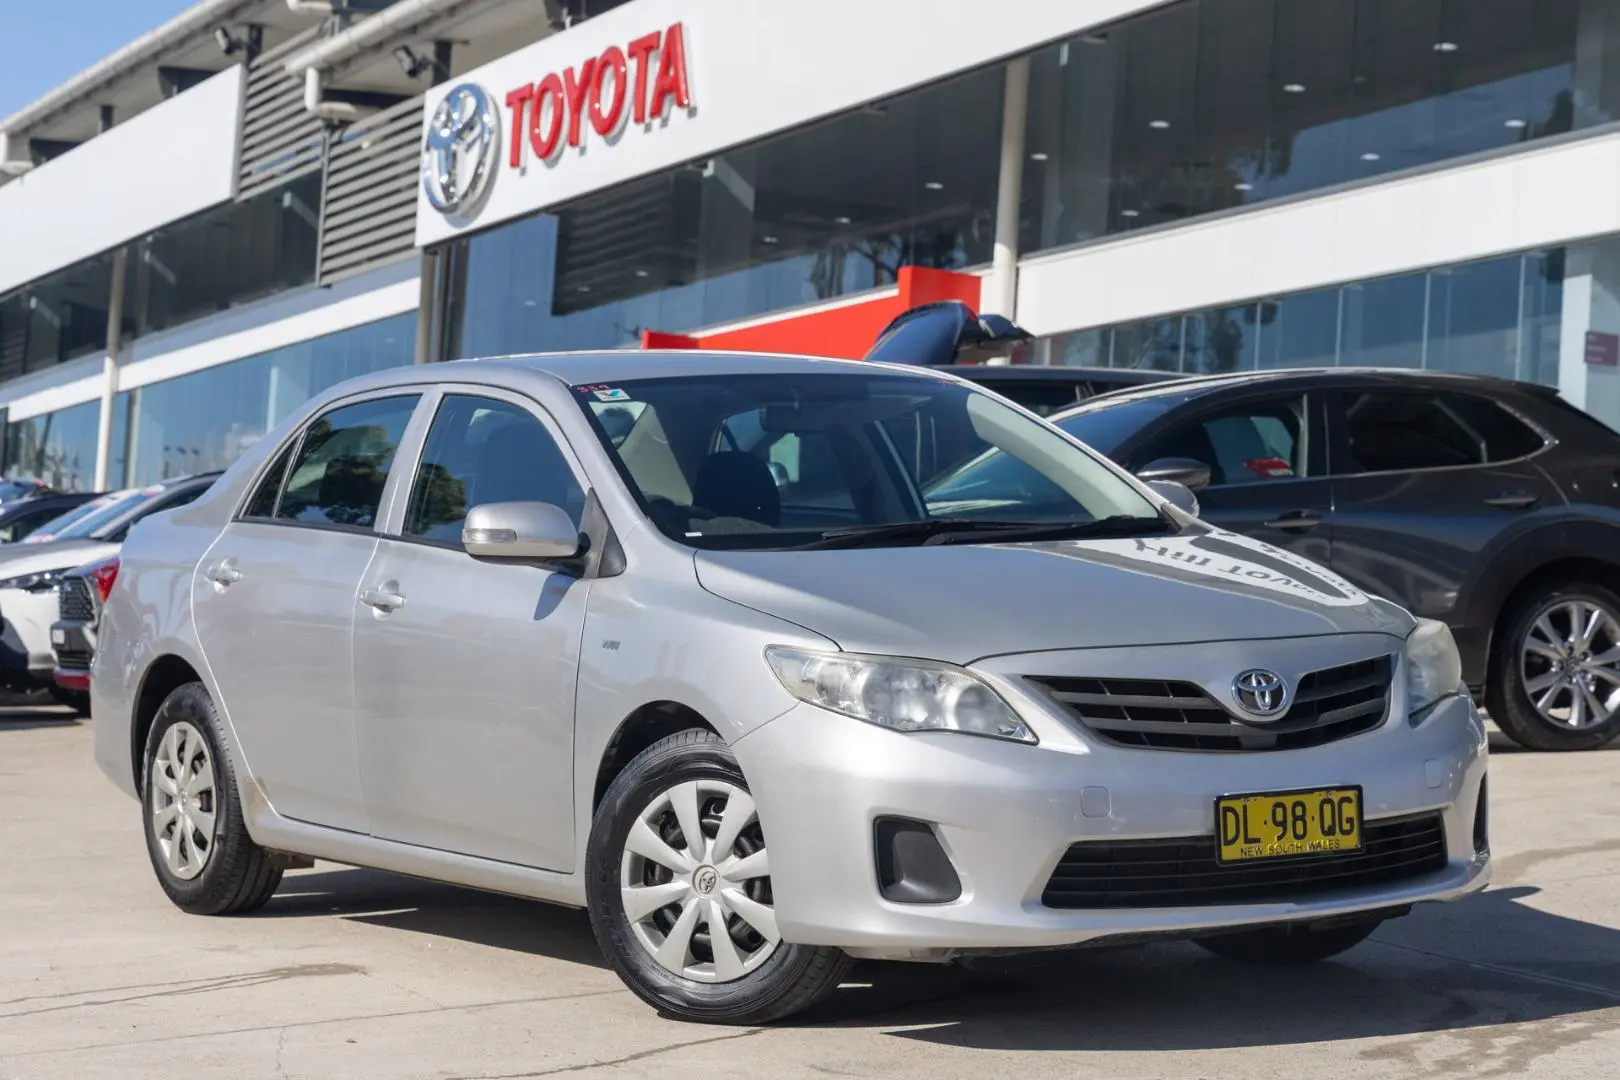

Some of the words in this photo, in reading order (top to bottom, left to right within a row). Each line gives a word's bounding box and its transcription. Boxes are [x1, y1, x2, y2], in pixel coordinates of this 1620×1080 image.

[506, 21, 690, 169] TOYOTA
[1240, 846, 1263, 857] NEW
[1267, 844, 1302, 855] SOUTH
[1307, 839, 1341, 851] WALES
